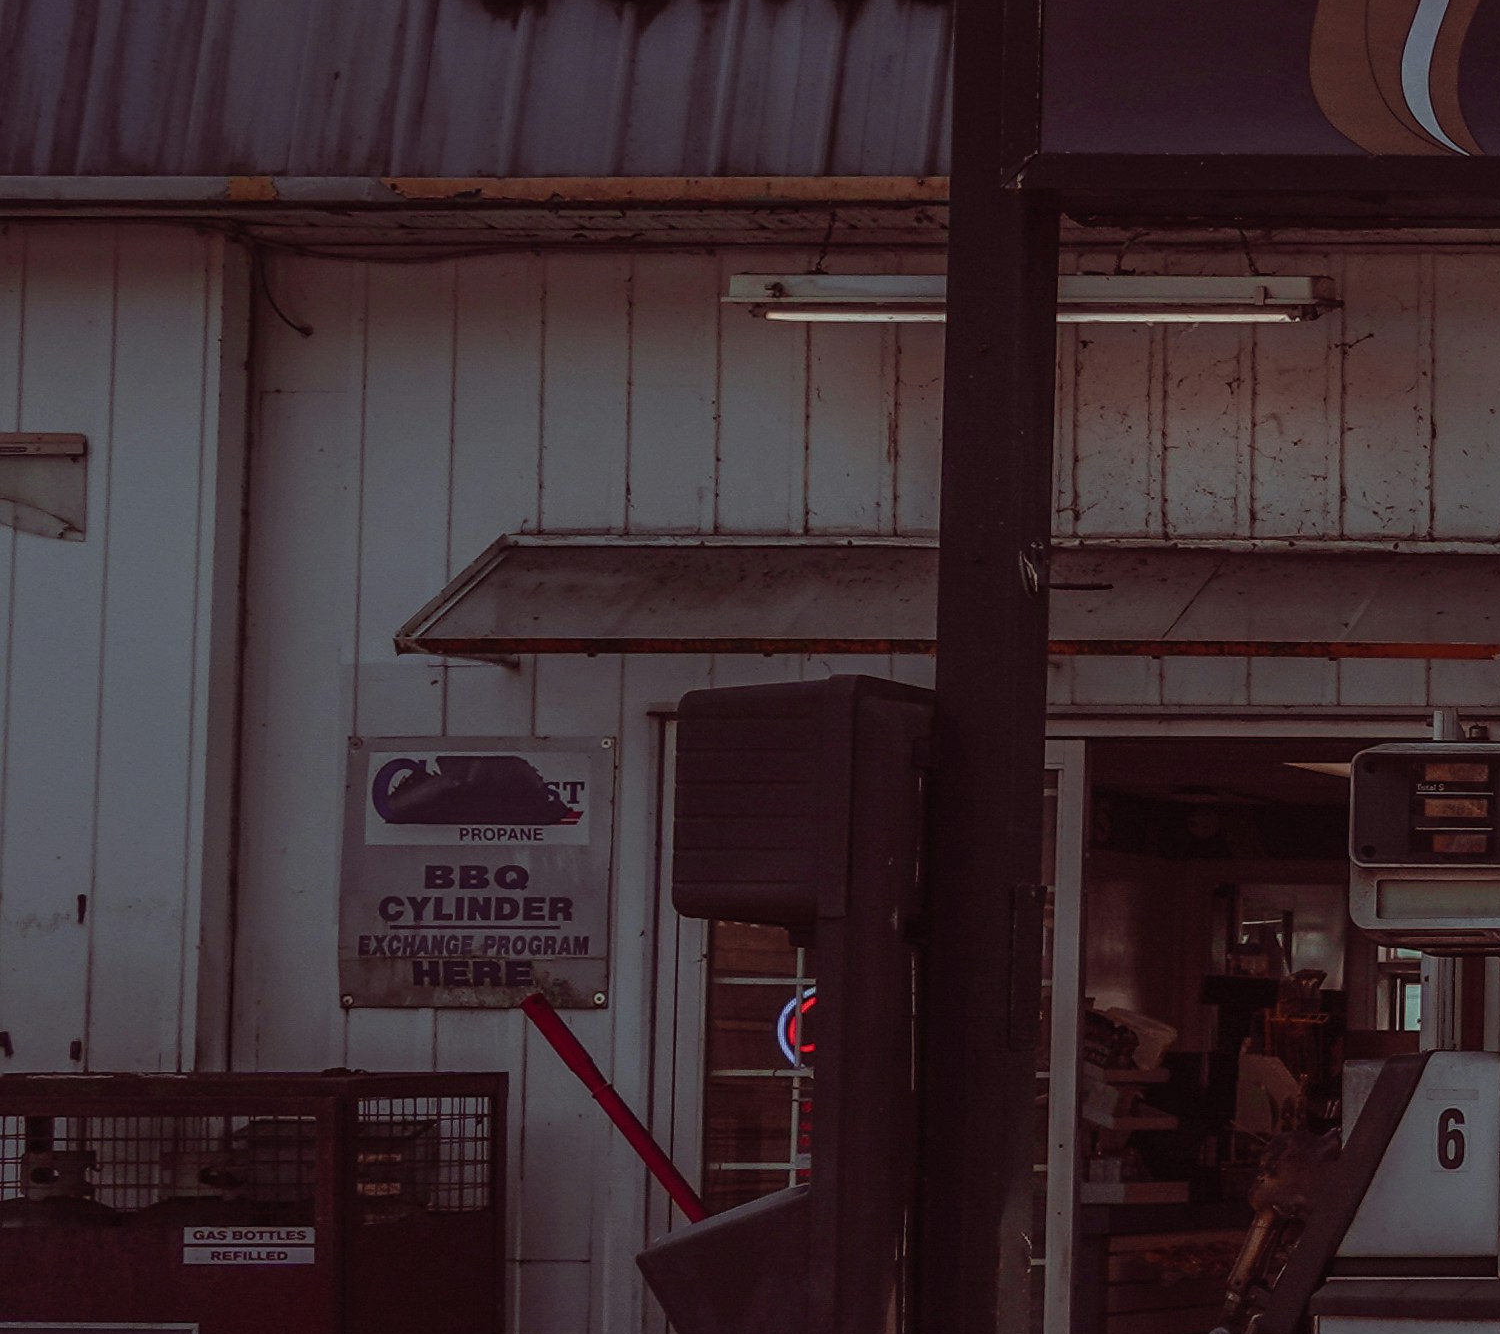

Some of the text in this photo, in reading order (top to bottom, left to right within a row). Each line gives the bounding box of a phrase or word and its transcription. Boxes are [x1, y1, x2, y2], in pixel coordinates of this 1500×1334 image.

[459, 827, 544, 842] PROPANE
[424, 864, 530, 890] BBQ
[378, 896, 573, 922] CYLINDER
[357, 935, 590, 956] EXCHANGE PROGRAM
[412, 960, 534, 986] HERE
[1437, 1107, 1466, 1170] 6
[193, 1229, 307, 1242] GAS BOTTLES
[210, 1250, 289, 1262] REFILLED
